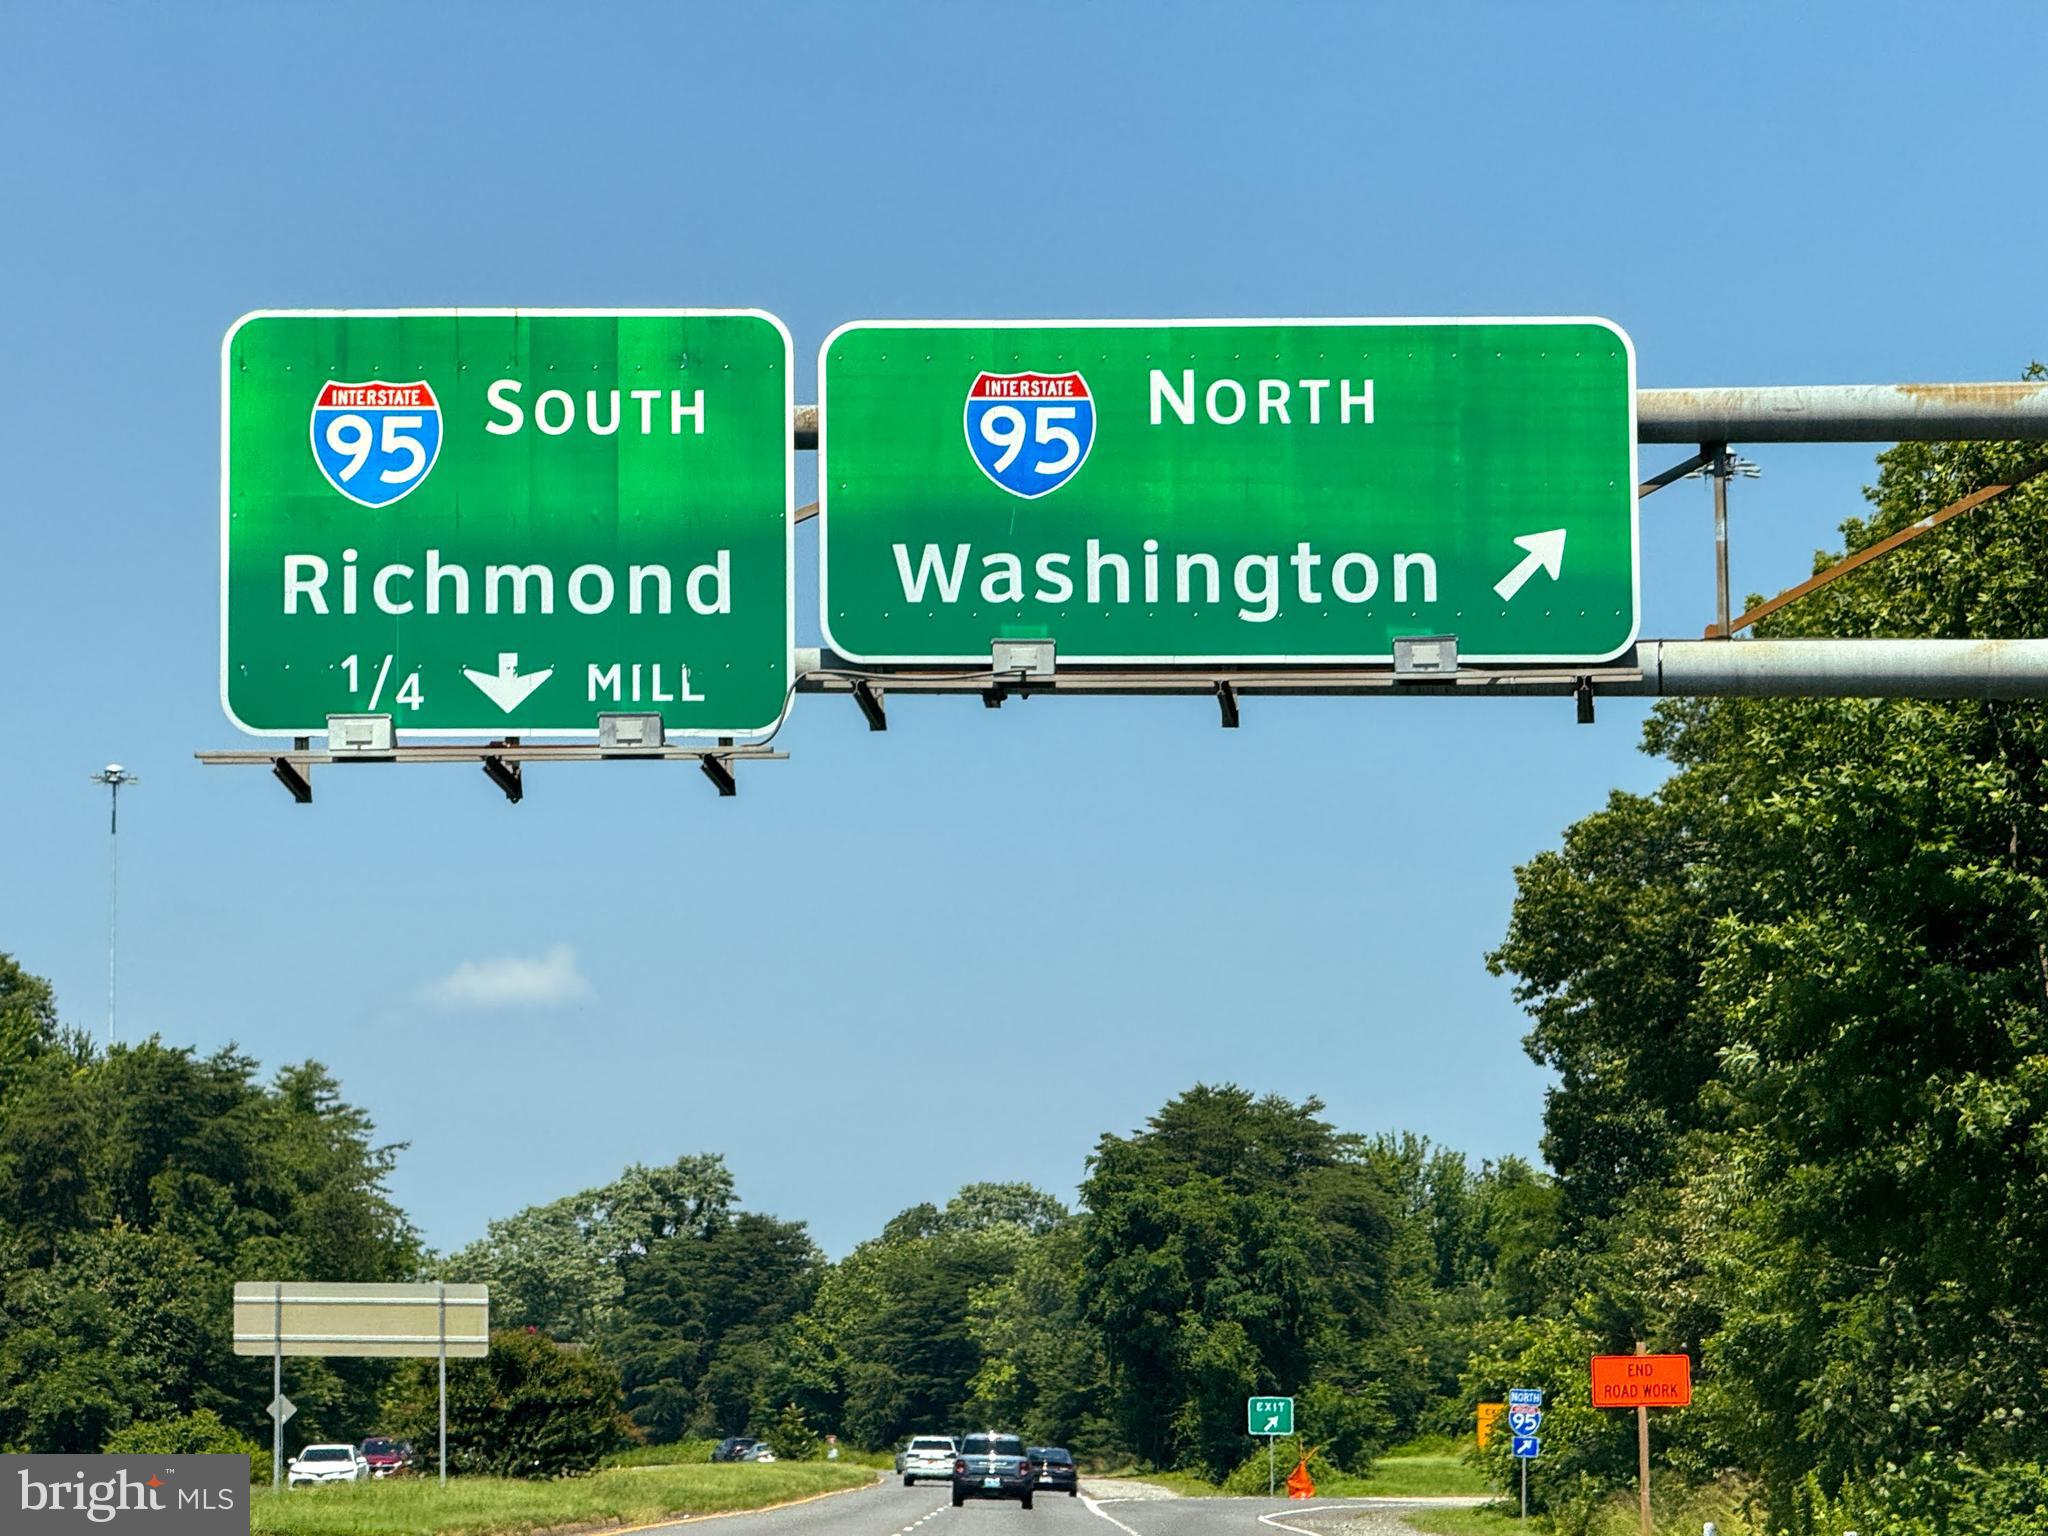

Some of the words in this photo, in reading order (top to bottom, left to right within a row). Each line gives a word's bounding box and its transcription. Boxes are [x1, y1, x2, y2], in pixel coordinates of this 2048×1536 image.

[332, 389, 420, 406] INTERSTATE
[985, 380, 1074, 396] INTERSTATE
[1149, 369, 1376, 426] NORTH
[485, 379, 706, 436] SOUTH
[326, 414, 426, 484] 95
[980, 405, 1080, 475] 95
[283, 549, 732, 615] Richmond
[893, 539, 1438, 623] Washington
[340, 654, 425, 711] 1/4
[1627, 1363, 1653, 1377] END
[1256, 1401, 1285, 1412] EXIT
[1511, 1392, 1540, 1402] NORTH
[1604, 1384, 1638, 1399] ROAD
[1643, 1383, 1679, 1398] WORK
[1512, 1414, 1537, 1431] 95
